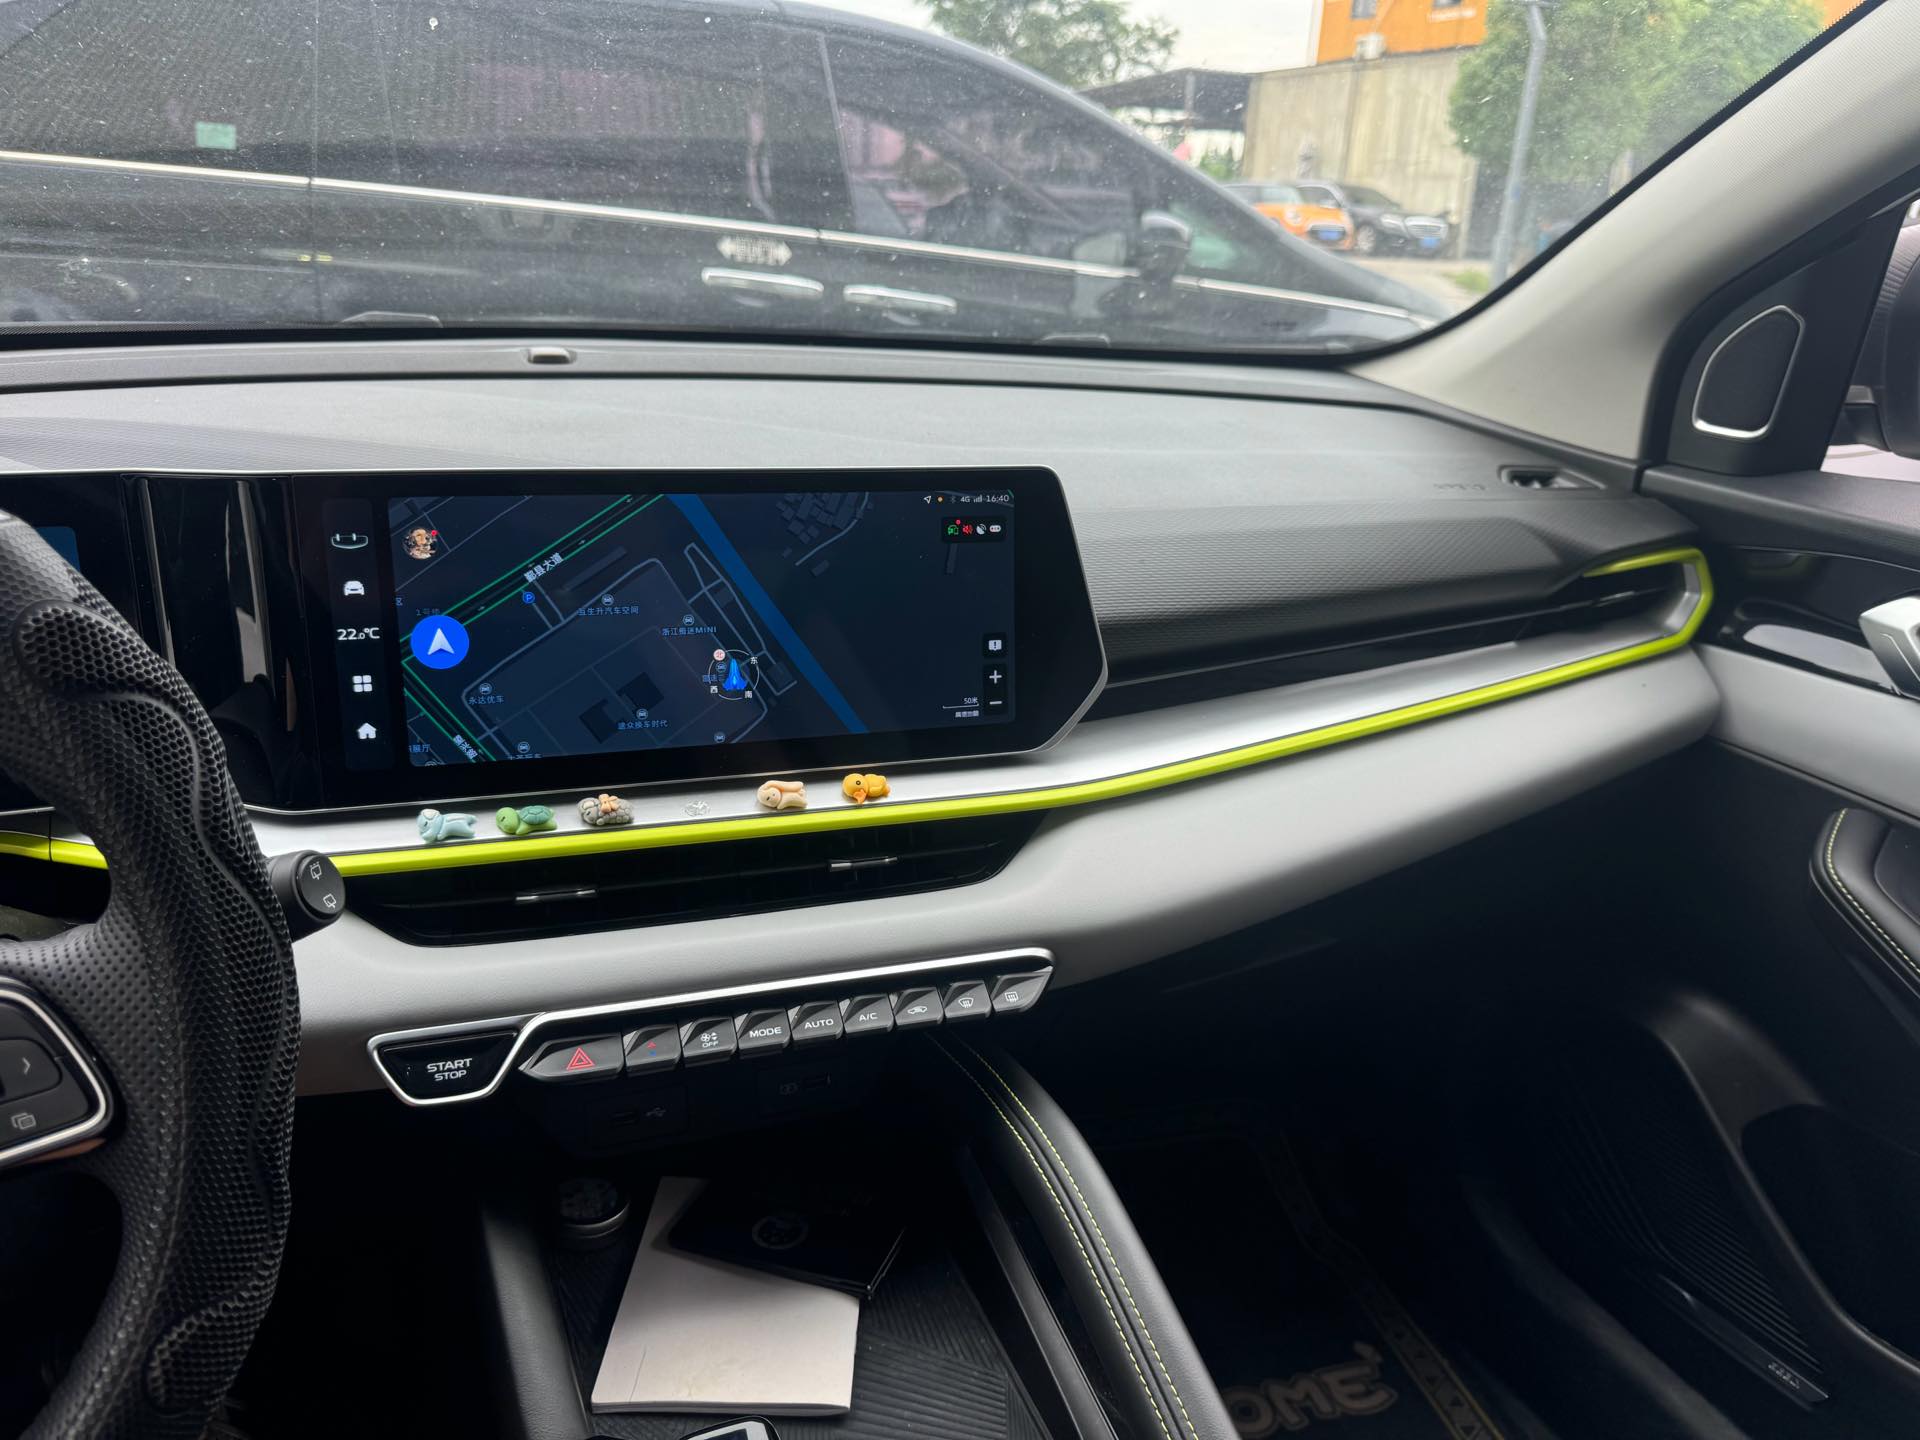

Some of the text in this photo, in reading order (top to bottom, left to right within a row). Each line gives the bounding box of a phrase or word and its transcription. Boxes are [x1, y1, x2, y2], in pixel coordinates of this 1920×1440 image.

[960, 495, 971, 504] 4G
[986, 494, 1010, 504] 16:40
[710, 685, 718, 694] 西
[744, 690, 753, 699] 南
[858, 1012, 878, 1022] A/C
[804, 1018, 834, 1029] AUTO
[749, 1026, 782, 1038] MODE
[702, 1040, 719, 1048] OFF
[426, 1057, 473, 1073] START
[434, 1069, 467, 1082] STOP
